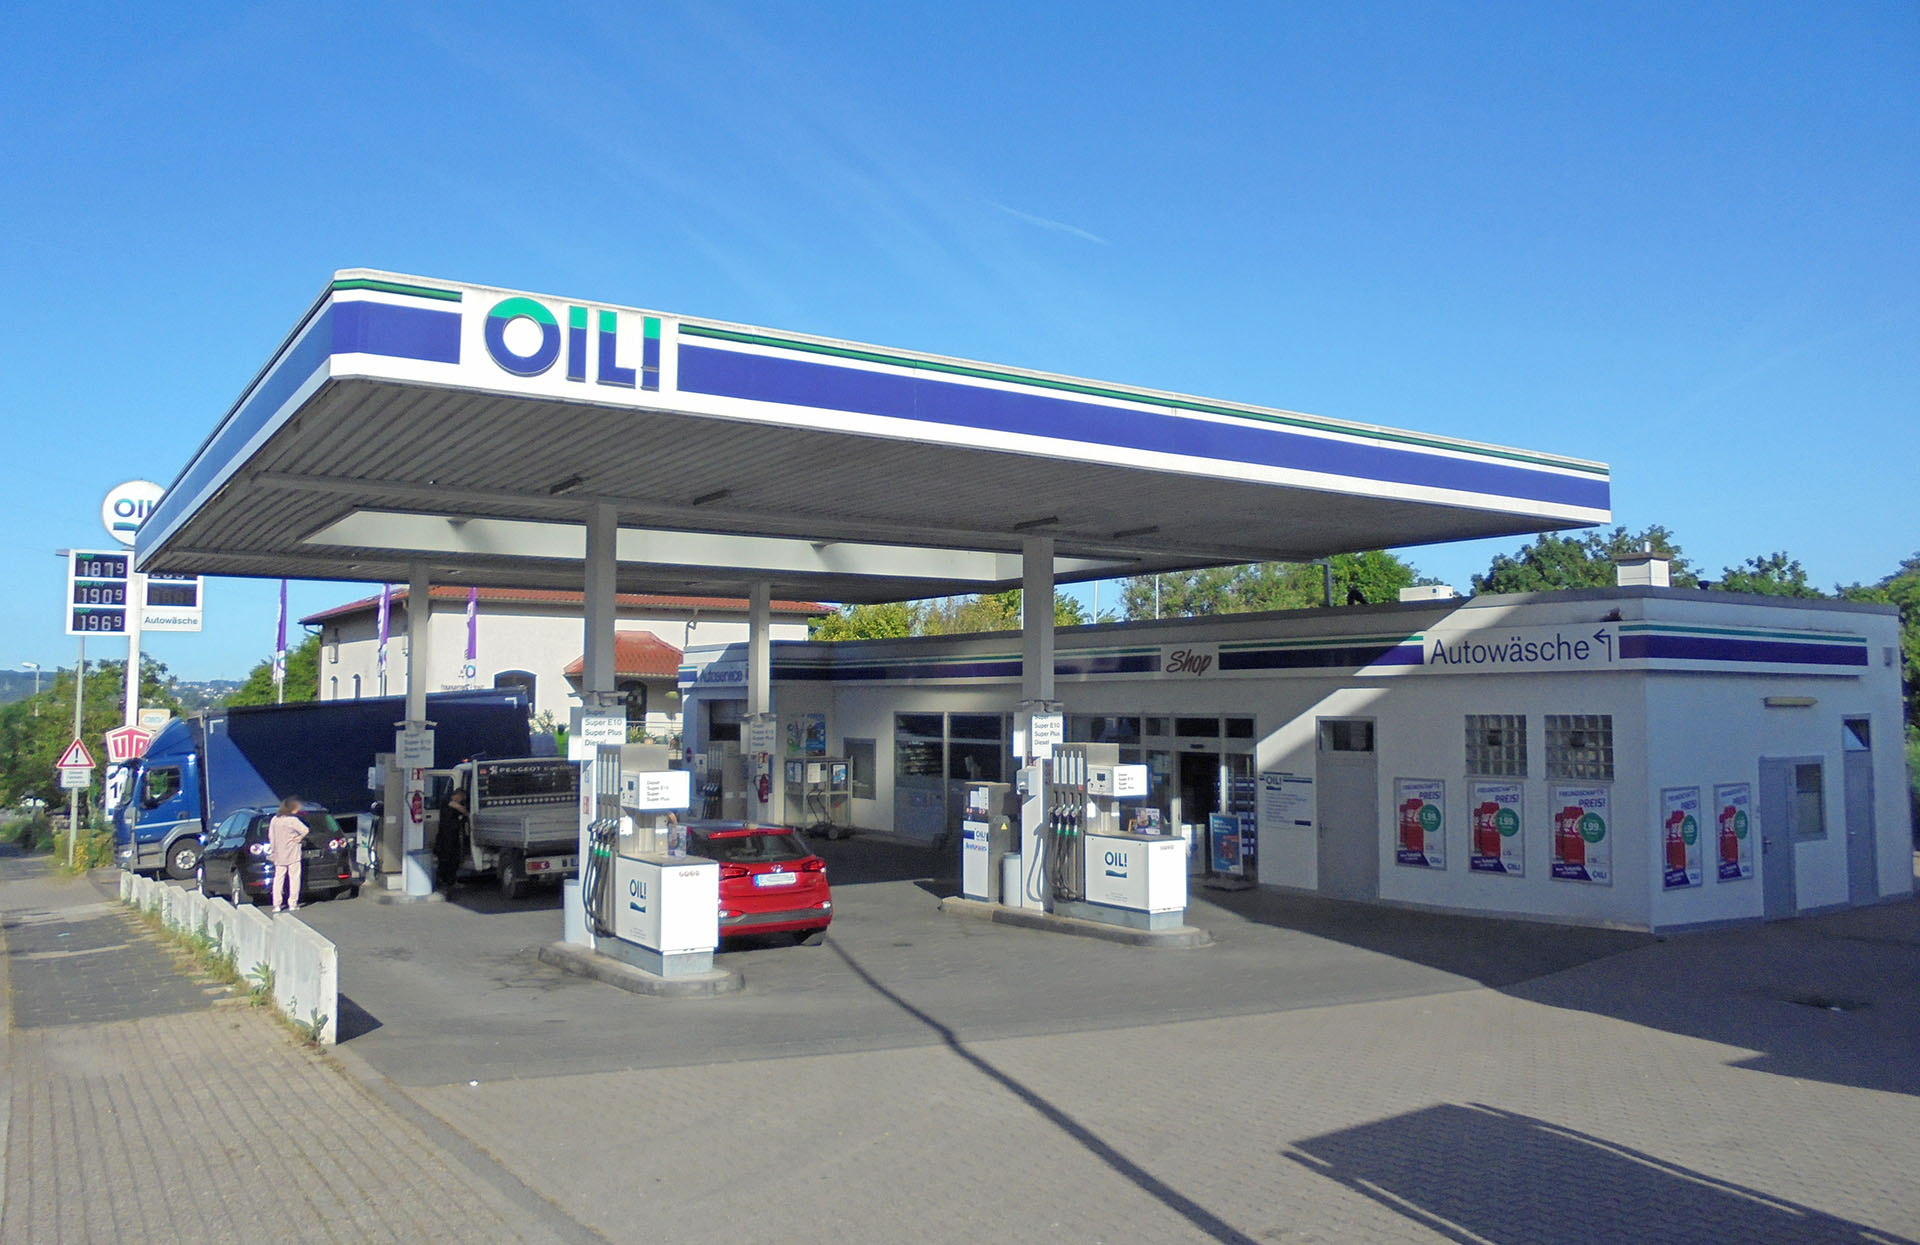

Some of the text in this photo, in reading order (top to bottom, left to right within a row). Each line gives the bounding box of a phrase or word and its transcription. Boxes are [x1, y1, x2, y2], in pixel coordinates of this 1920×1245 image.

[483, 296, 661, 392] OIL!
[144, 615, 198, 625] Autowäsche
[1430, 633, 1590, 664] Autowäsche
[1165, 649, 1212, 676] Shop
[585, 719, 606, 727] Super
[585, 729, 606, 737] Super
[1495, 794, 1520, 803] PREIS!
[1578, 798, 1606, 808] PREIS!
[1104, 851, 1127, 868] OIL!
[629, 878, 647, 899] OIL!
